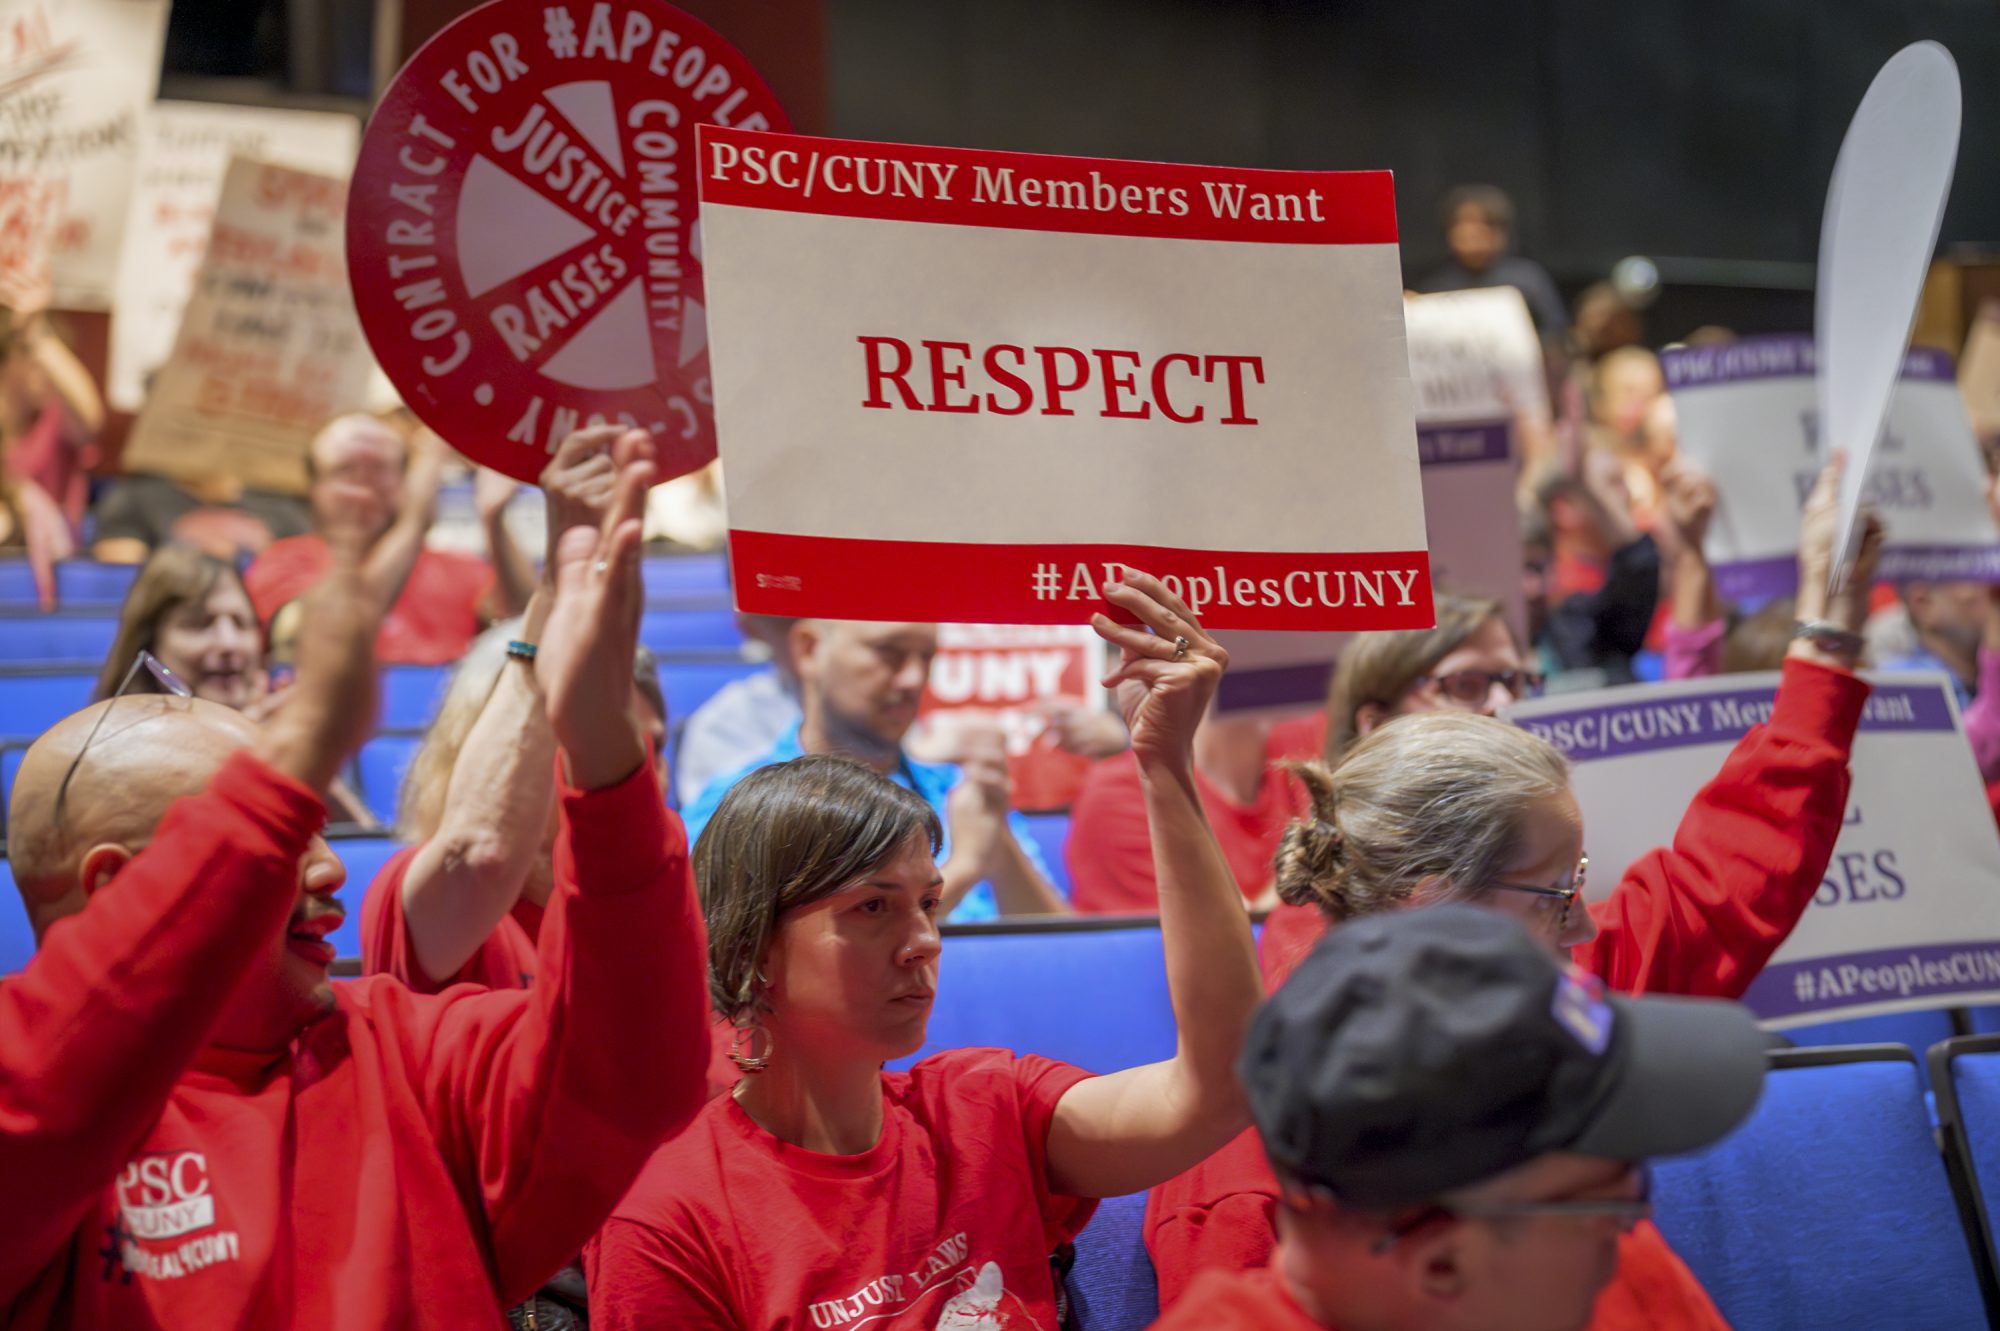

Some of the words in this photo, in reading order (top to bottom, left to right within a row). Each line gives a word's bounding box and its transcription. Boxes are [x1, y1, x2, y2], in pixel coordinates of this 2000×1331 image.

[385, 113, 471, 377] CONTRACT
[439, 32, 529, 114] FOR
[491, 103, 639, 237] JUSTICE
[627, 100, 681, 332] COMMUNITY
[709, 141, 958, 200] PSC/CUNY
[971, 165, 1190, 217] Members
[1201, 181, 1325, 222] Want
[489, 244, 627, 362] RAISES
[856, 335, 1266, 425] RESPECT
[1032, 562, 1419, 616] #APoplesCUNY
[116, 1152, 209, 1208] PSC
[808, 1274, 907, 1328] UNJUST
[908, 1232, 969, 1288] LAWS
